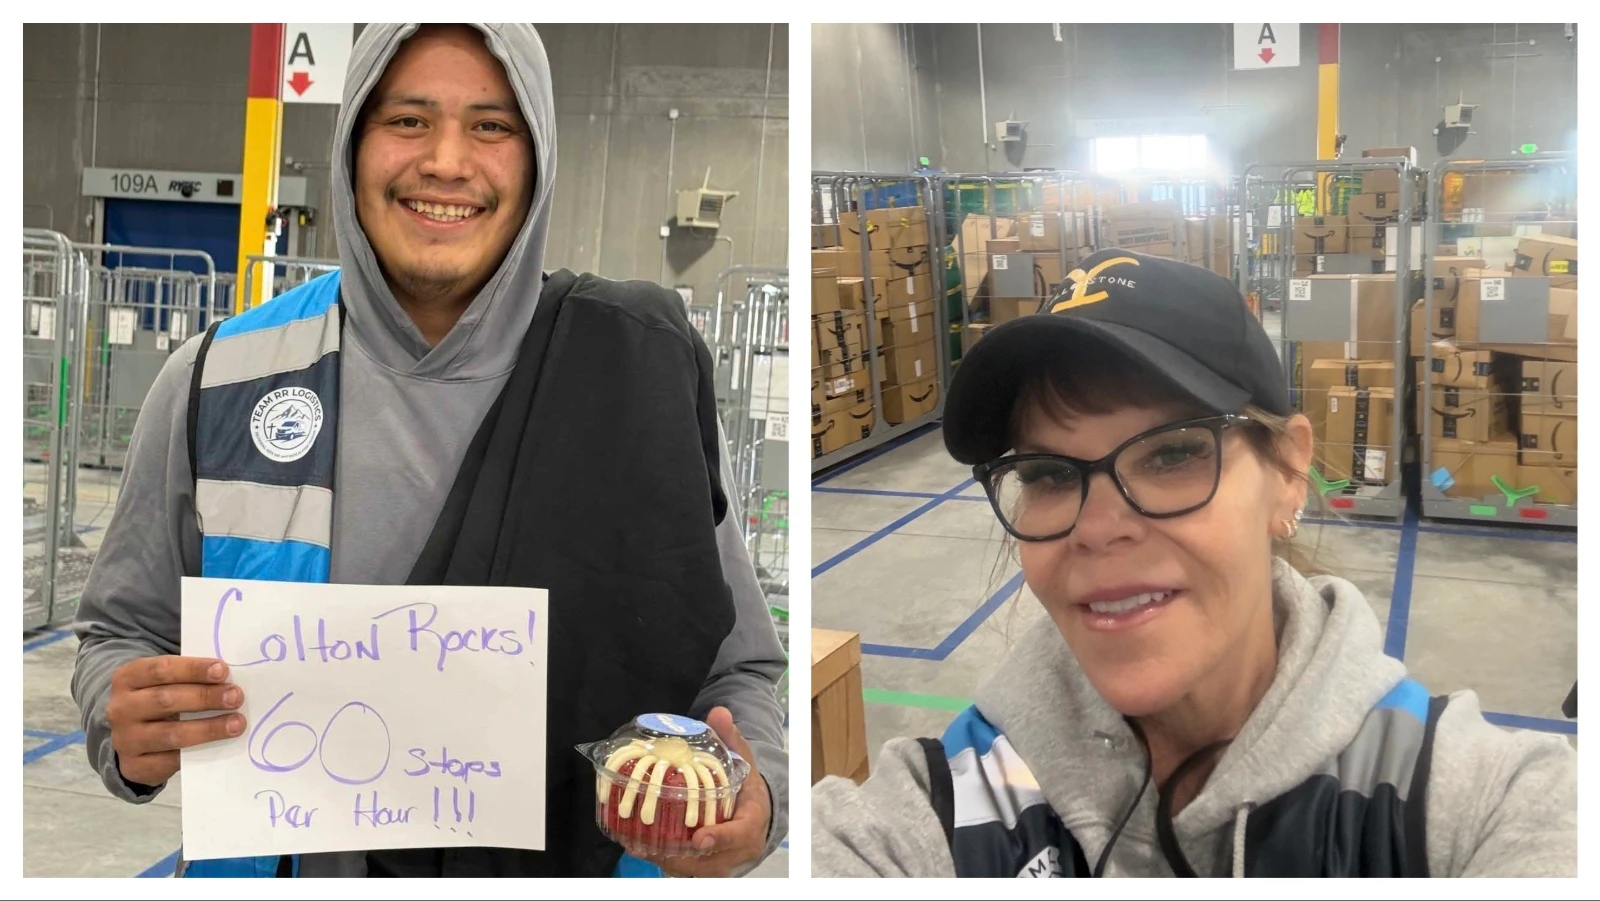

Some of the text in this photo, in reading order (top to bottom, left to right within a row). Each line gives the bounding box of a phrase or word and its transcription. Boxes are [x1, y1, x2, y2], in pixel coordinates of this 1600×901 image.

[288, 32, 315, 65] A
[1258, 23, 1276, 44] A
[111, 173, 158, 193] 109A
[252, 388, 322, 423] TEAM RR LOGISTICS
[248, 691, 502, 785] 60 Stops
[254, 789, 319, 828] Per
[1027, 858, 1047, 878] M
